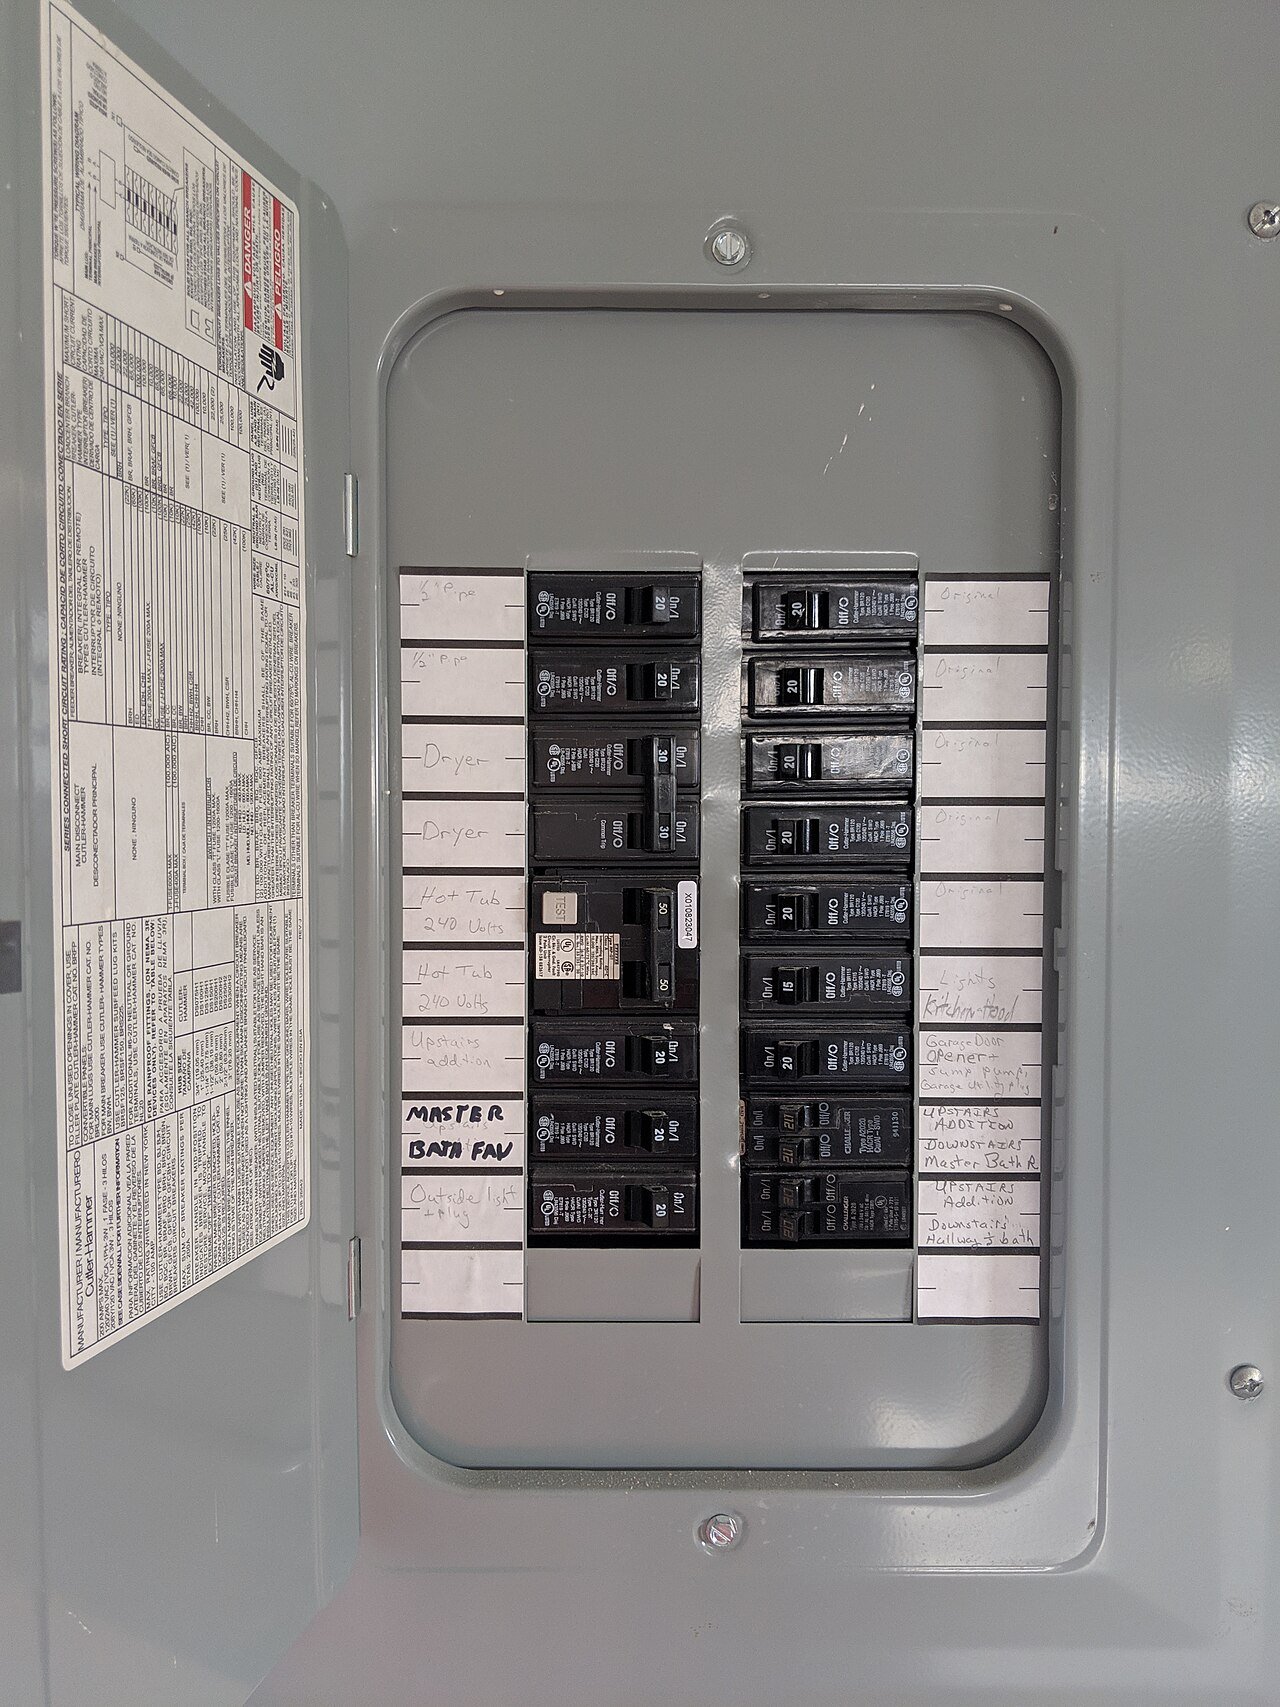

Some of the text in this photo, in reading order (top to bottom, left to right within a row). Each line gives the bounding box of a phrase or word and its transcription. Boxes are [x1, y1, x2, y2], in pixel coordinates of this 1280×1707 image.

[76, 558, 82, 573] OR
[90, 592, 95, 608] DE
[655, 596, 665, 610] 20
[940, 587, 1000, 604] Original
[792, 602, 802, 616] 20
[935, 657, 1000, 679] Original
[657, 673, 667, 687] 20
[787, 680, 797, 693] 20
[934, 732, 998, 751] Original
[424, 743, 489, 775] Dryer
[658, 749, 667, 762] 30
[785, 756, 795, 769] 20
[936, 808, 1000, 825] Original
[423, 821, 488, 847] Dryer
[659, 826, 668, 838] 30
[782, 831, 792, 844] 20
[421, 887, 500, 905] Hot Tub
[936, 882, 1002, 899] Original
[555, 896, 565, 921] TEST
[659, 902, 667, 914] 50
[783, 908, 792, 920] 20
[424, 917, 504, 934] 240 Volts
[418, 963, 492, 980] Hot Tub
[940, 967, 996, 991] Lights
[660, 979, 668, 991] 50
[783, 982, 793, 992] 15
[419, 994, 449, 1012] 240
[926, 1033, 1005, 1051] Garage Door
[655, 1051, 665, 1063] 20
[783, 1057, 793, 1070] 20
[405, 1104, 504, 1123] MASTER
[655, 1129, 664, 1141] 20
[408, 1140, 463, 1159] BATH
[925, 1155, 979, 1170] Master
[73, 1150, 82, 1252] MANUFACTURERO
[410, 1184, 516, 1206] Outside light
[656, 1204, 665, 1216] 20
[1000, 1229, 1034, 1245] bath
[85, 1195, 95, 1297] Cutler-Hammer
[75, 1258, 85, 1350] MANUFACTURER
